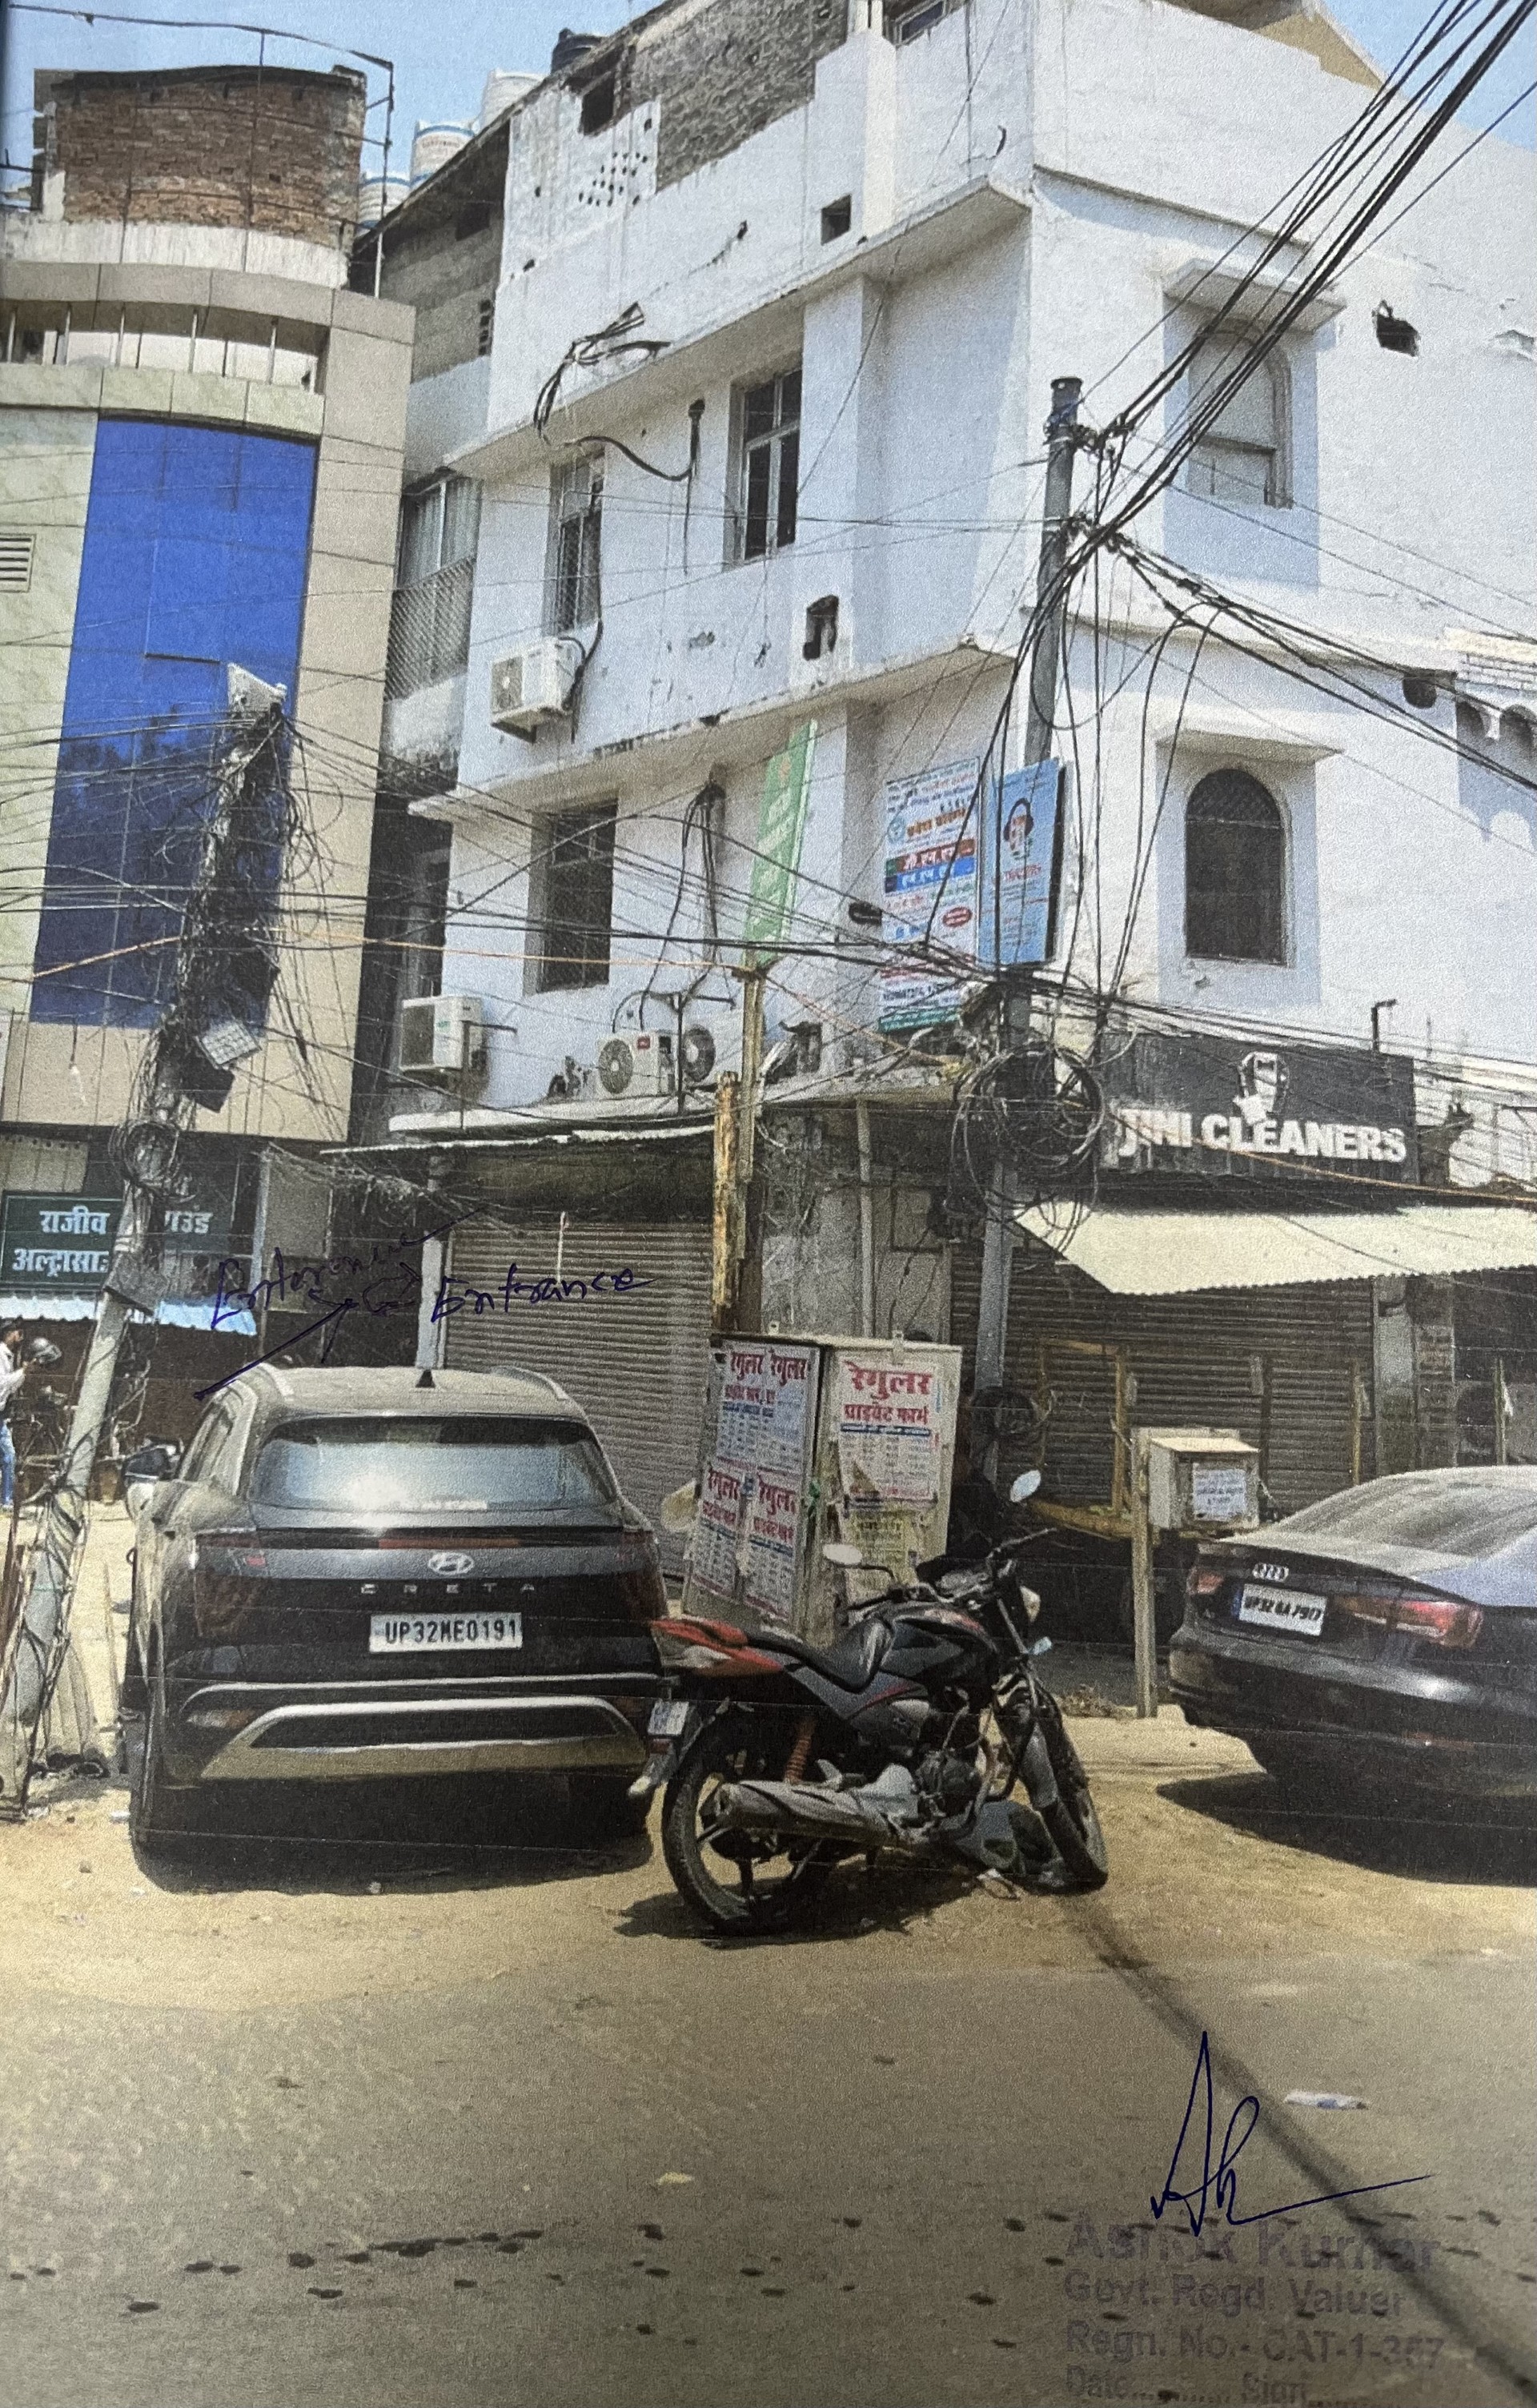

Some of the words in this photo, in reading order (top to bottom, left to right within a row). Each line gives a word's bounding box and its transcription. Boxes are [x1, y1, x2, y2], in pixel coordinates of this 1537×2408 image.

[1201, 1113, 1407, 1163] CLEANERS
[39, 1205, 111, 1235] राजीव
[431, 1262, 655, 1323] Entrance
[843, 1359, 933, 1400] रेगुलर
[360, 1582, 536, 1595] CRETA
